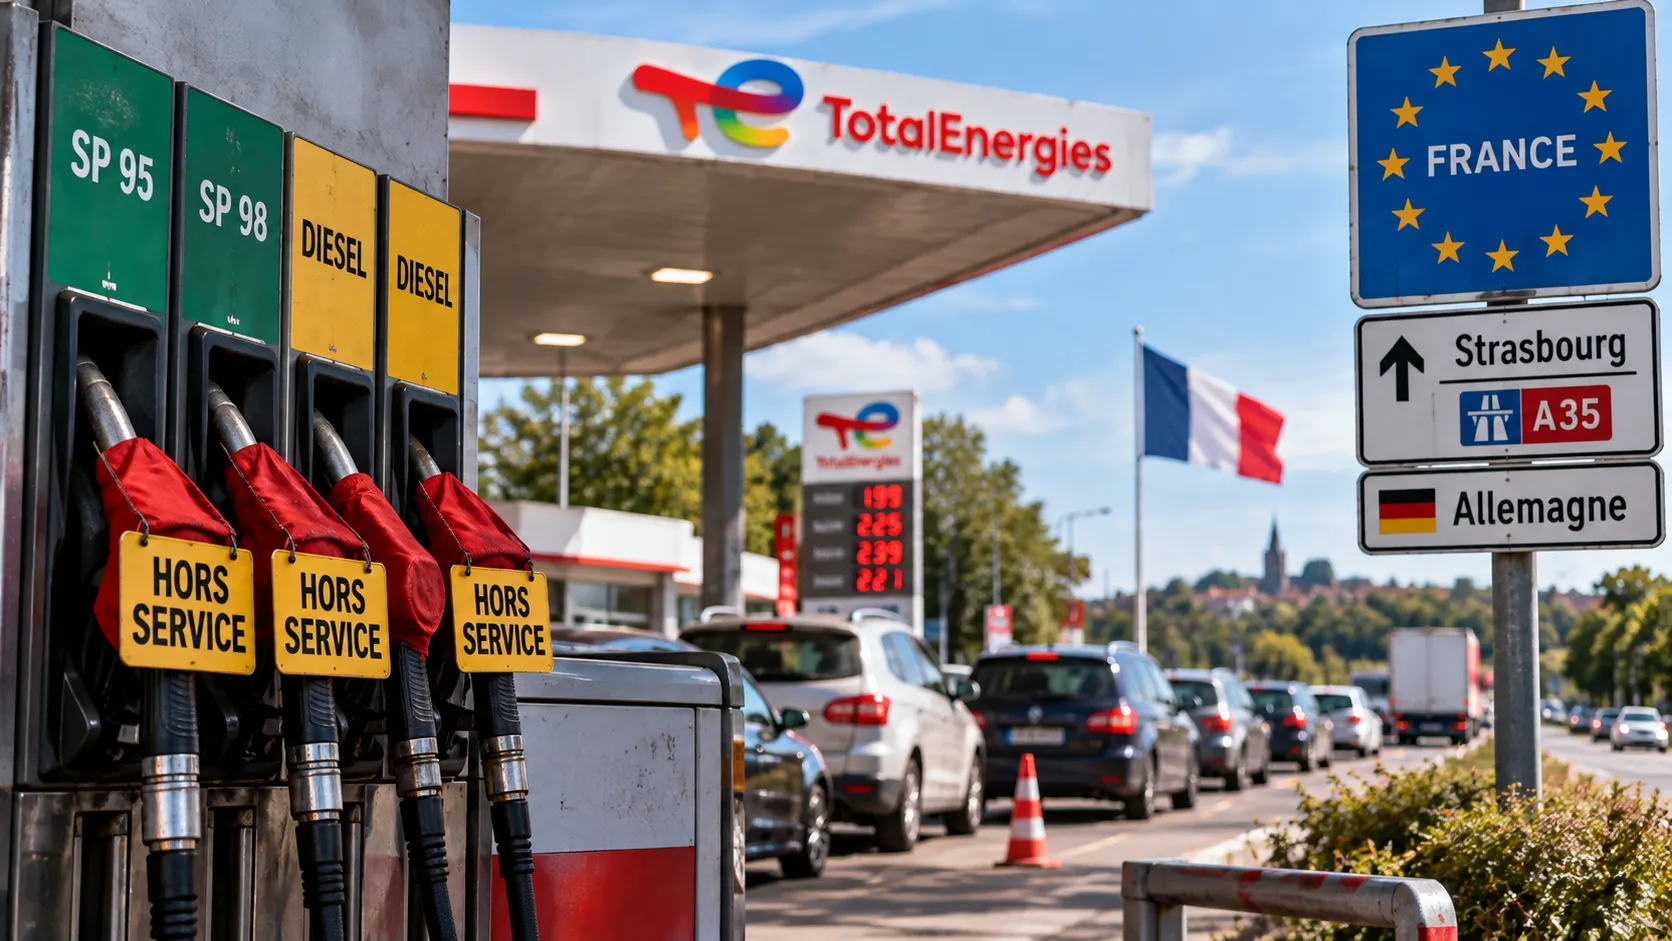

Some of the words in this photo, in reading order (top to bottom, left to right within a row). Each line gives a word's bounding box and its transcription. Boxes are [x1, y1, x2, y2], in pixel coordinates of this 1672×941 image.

[822, 95, 1112, 178] TotalEnergies
[1427, 133, 1577, 177] FRANCE
[70, 129, 111, 184] SP
[119, 148, 154, 202] 95
[199, 179, 232, 227] SP
[239, 195, 268, 242] 98
[301, 218, 367, 279] DIESEL
[396, 254, 453, 309] DIESEL
[1455, 330, 1627, 368] Strasbourg
[1532, 397, 1601, 433] A35
[1453, 490, 1627, 532] Allemagne
[153, 556, 229, 605] HORS
[301, 571, 366, 615] HORS
[474, 583, 531, 618] HORS
[132, 603, 246, 654] SERVICE
[284, 616, 382, 660] SERVICE
[462, 621, 547, 657] SERVICE
